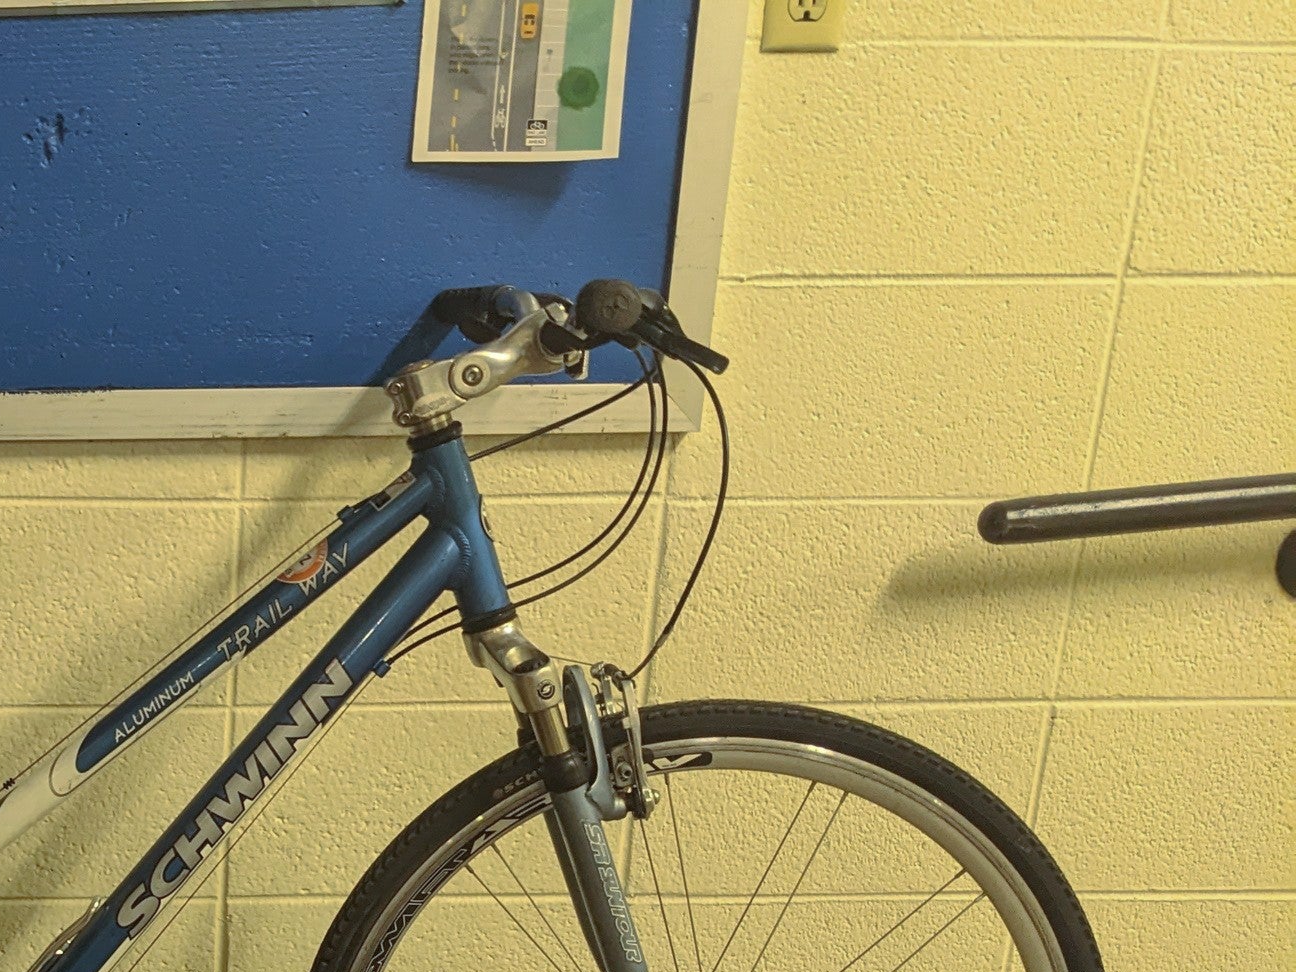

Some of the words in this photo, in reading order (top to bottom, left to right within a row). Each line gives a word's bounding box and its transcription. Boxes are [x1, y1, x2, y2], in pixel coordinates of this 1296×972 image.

[114, 671, 195, 743] ALUMINUM
[217, 600, 293, 662] TRAIL
[298, 542, 348, 595] WAY
[115, 656, 357, 940] SCHWINN
